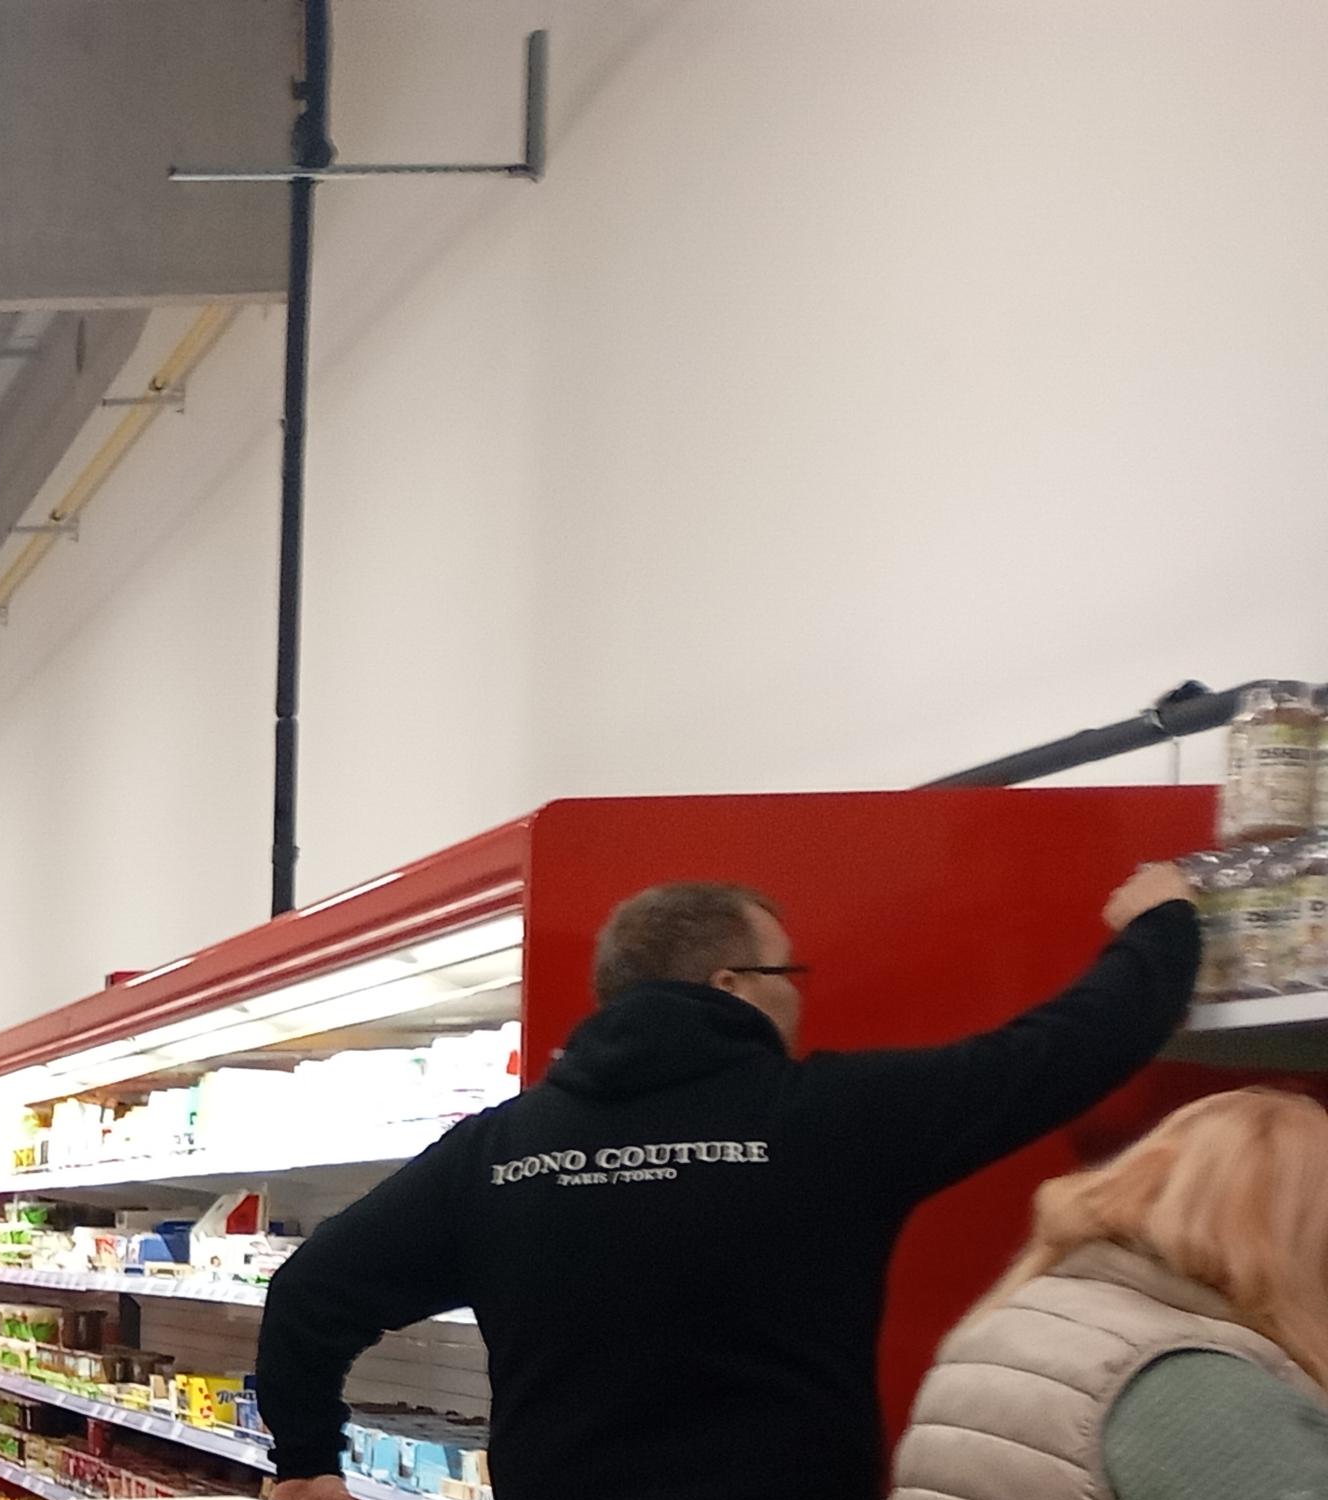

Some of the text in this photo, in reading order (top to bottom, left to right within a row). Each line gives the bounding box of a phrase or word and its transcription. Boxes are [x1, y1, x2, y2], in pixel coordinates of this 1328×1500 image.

[491, 1141, 769, 1185] ICONO COUTURE
[556, 1171, 608, 1186] PARIS
